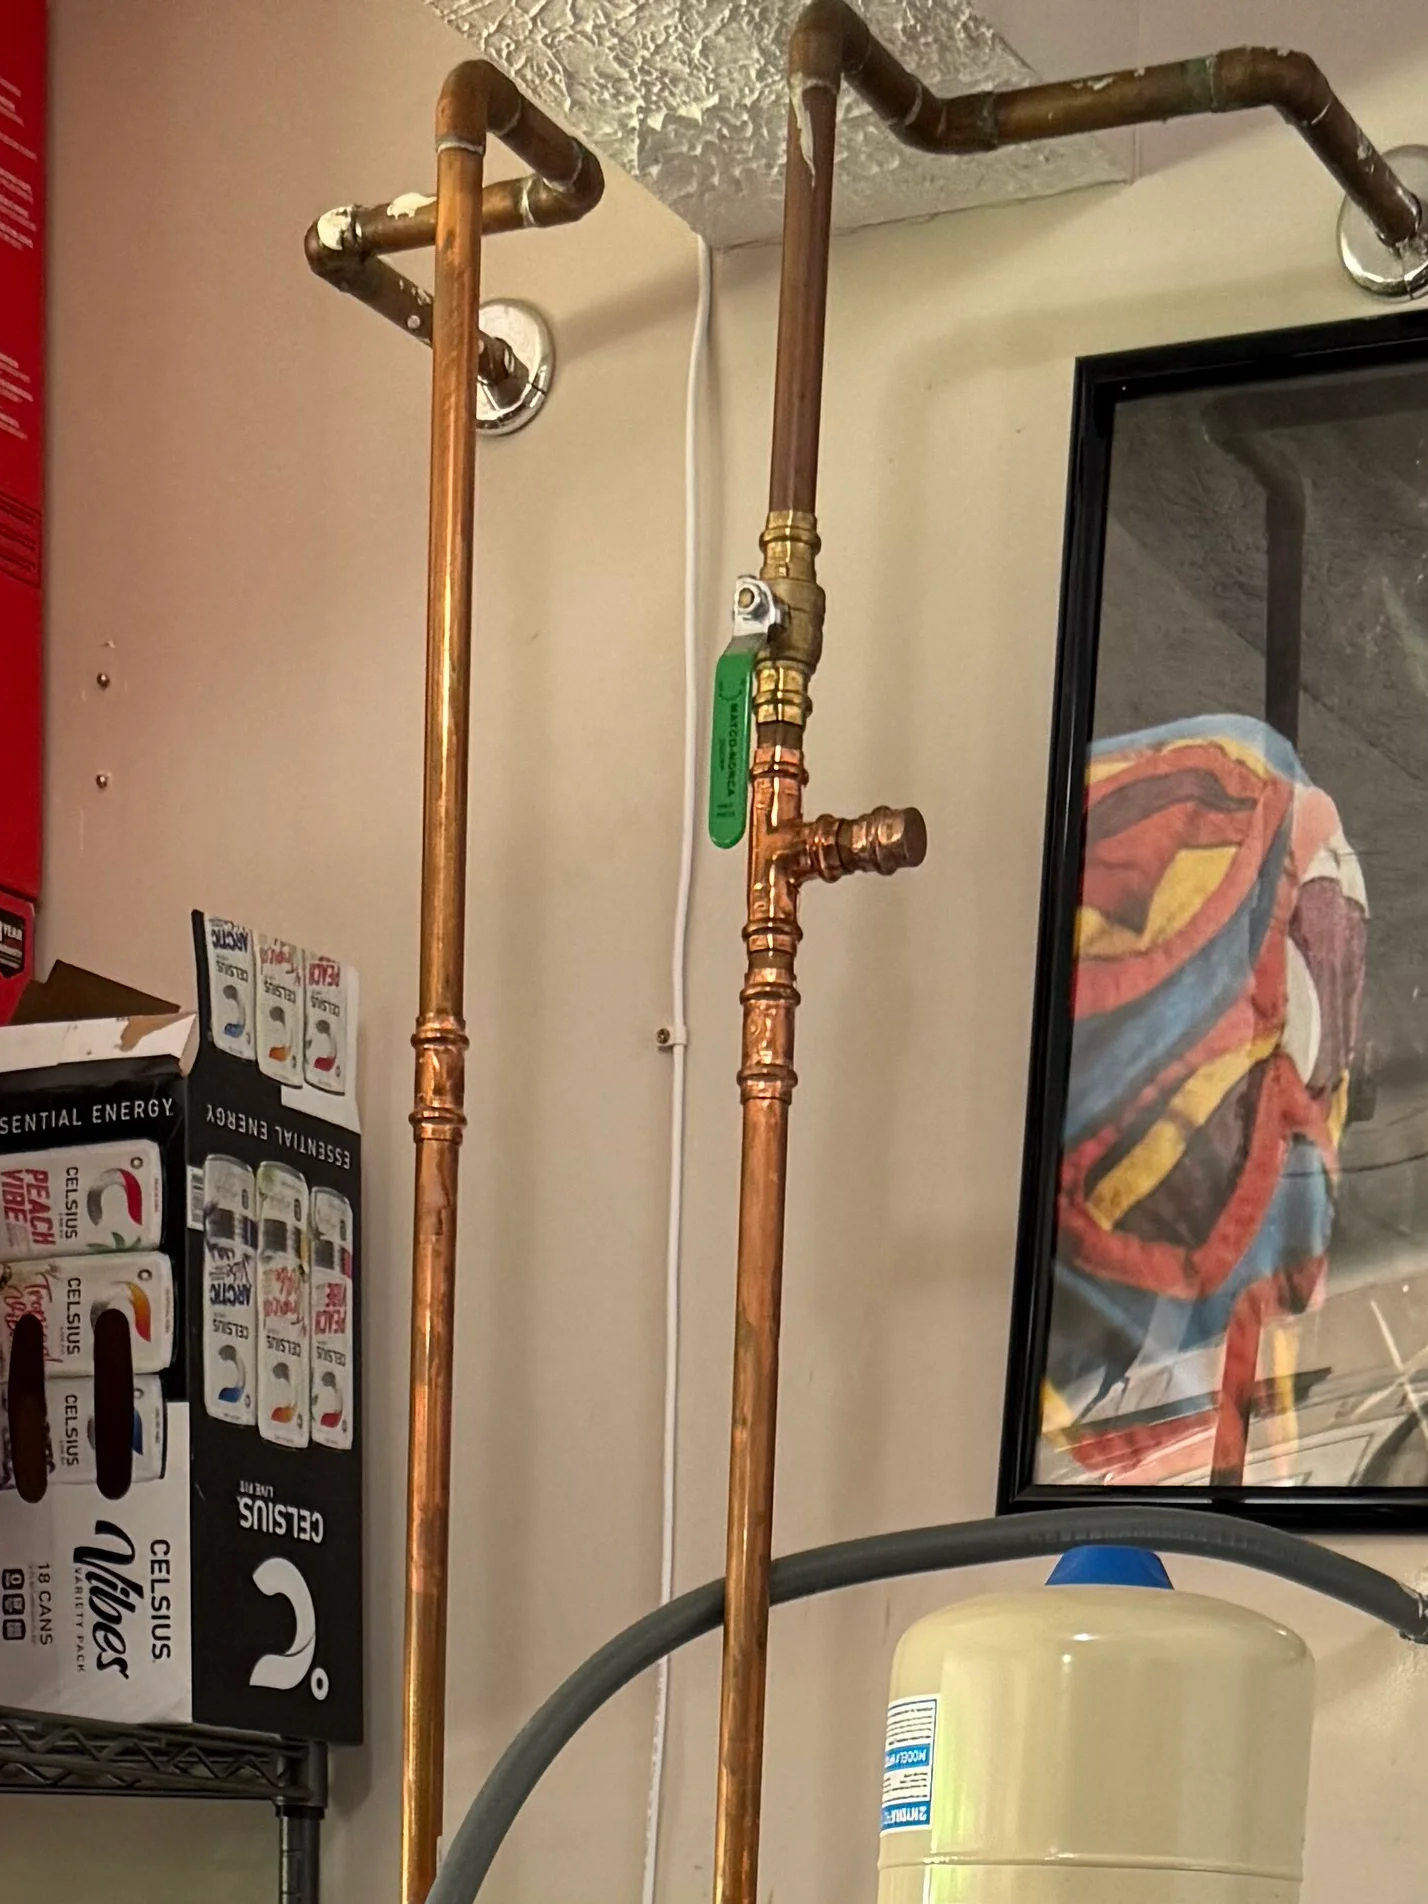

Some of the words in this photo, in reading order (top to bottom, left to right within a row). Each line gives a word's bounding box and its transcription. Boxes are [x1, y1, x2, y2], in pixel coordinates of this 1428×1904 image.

[91, 1097, 174, 1124] ENERGY
[206, 1103, 268, 1140] ENERGY
[275, 1125, 351, 1170] ESSENTIAL
[0, 1168, 29, 1225] VIBE
[26, 1168, 57, 1246] PEACH
[65, 1166, 80, 1240] CELSIUS
[66, 1276, 82, 1356] CELSIUS
[209, 1283, 253, 1307] ARCTIC
[213, 1318, 249, 1341] CELSIUS
[266, 1334, 302, 1358] CELSIUS
[64, 1393, 80, 1467] CELSIUS
[239, 1497, 325, 1544] CELSIUS
[38, 1563, 50, 1584] 18
[74, 1568, 85, 1628] VARIETY
[39, 1594, 53, 1646] CANS
[73, 1520, 144, 1679] Vibes
[150, 1539, 171, 1660] CELSIUS
[77, 1638, 86, 1672] PACK
